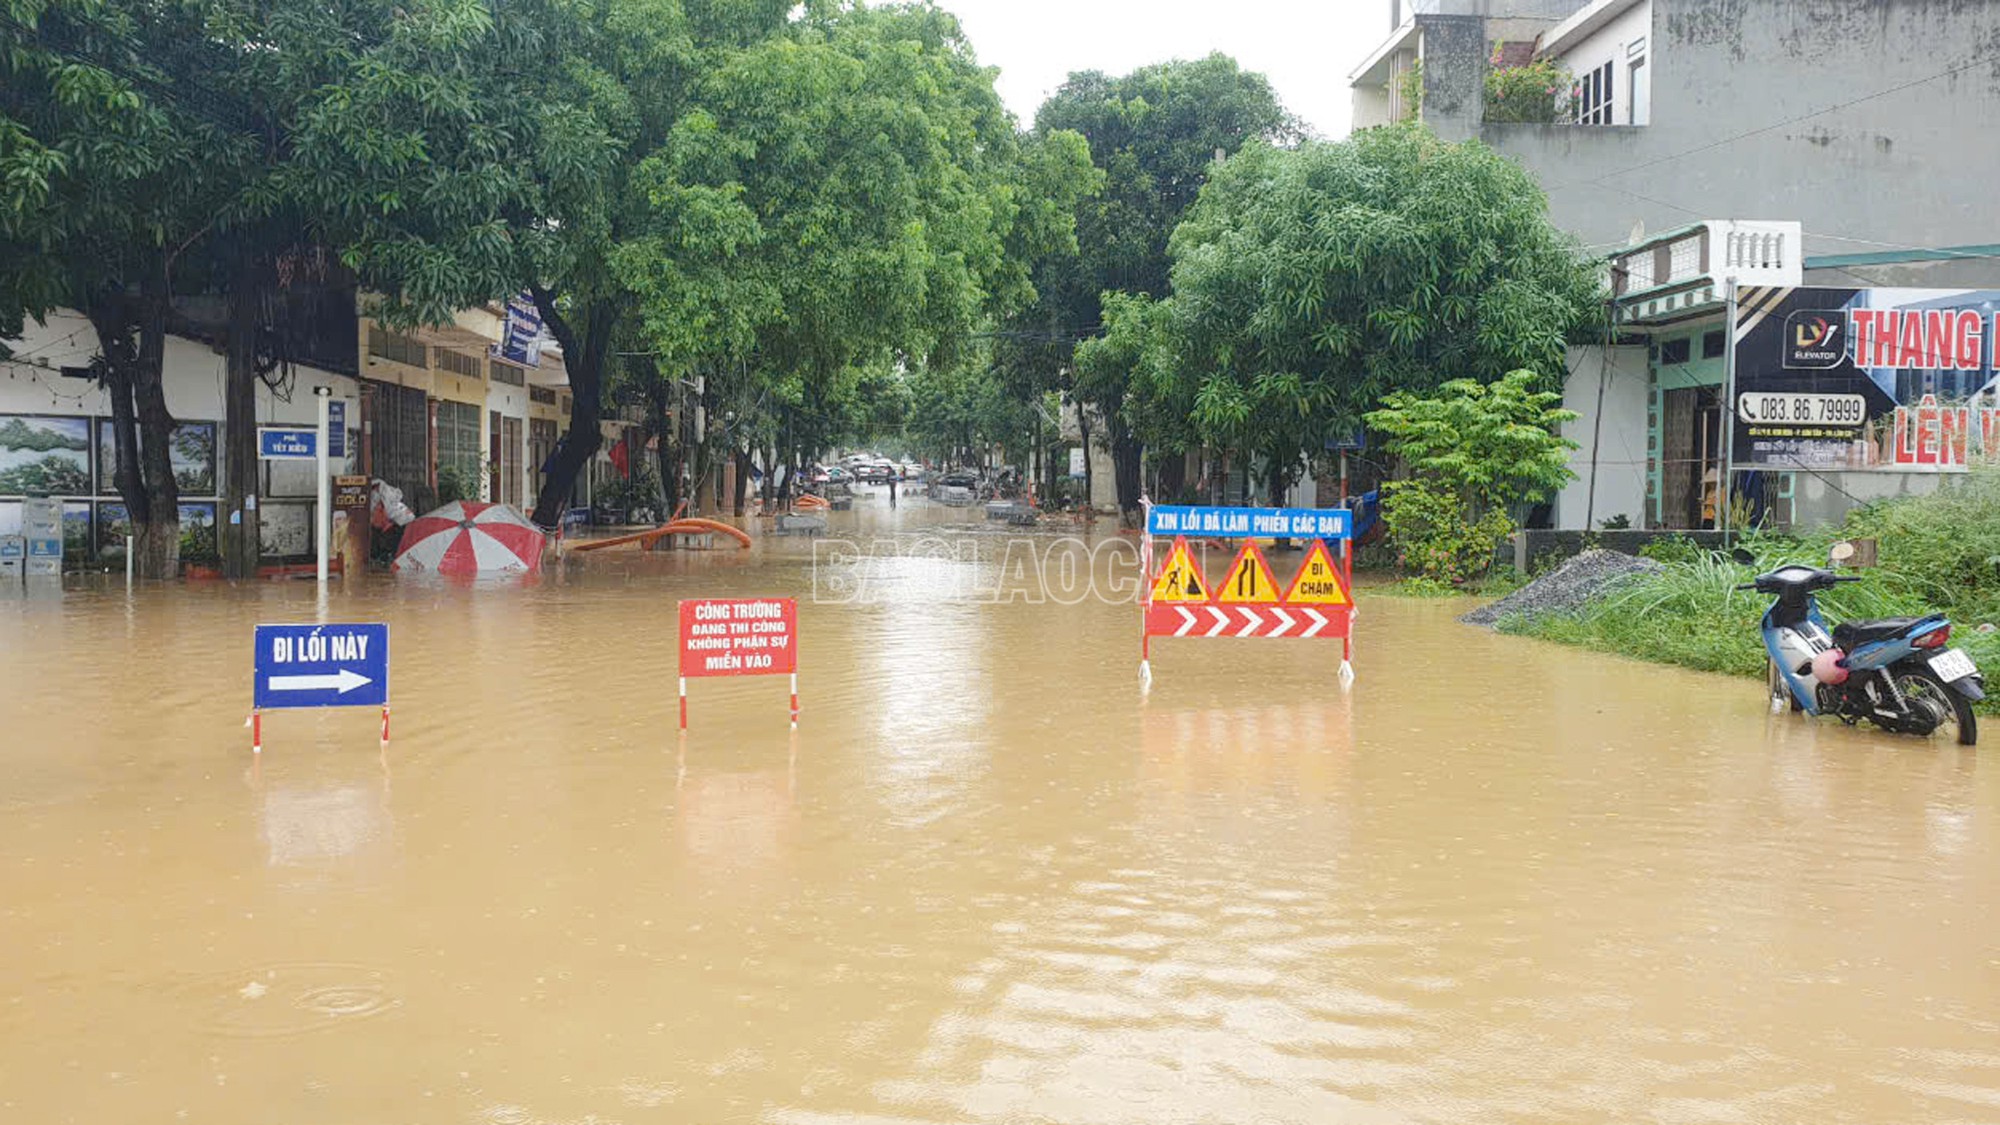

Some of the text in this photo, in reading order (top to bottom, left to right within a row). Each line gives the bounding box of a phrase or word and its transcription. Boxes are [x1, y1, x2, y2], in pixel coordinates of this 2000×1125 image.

[1852, 308, 1982, 370] THANG
[1795, 351, 1836, 360] ELEVATOR
[1894, 394, 1968, 466] LÊN
[1156, 511, 1177, 530] XIN
[1222, 510, 1249, 531] LÀM
[1293, 513, 1316, 534] CÁC
[1318, 516, 1342, 537] BẠN
[1312, 563, 1322, 575] ĐI
[695, 601, 730, 620] CÔNG
[729, 622, 749, 635] THI
[752, 619, 786, 633] CÔNG
[273, 626, 368, 663] ĐI LỐI NÀY
[687, 636, 731, 650] KHÔNG
[770, 634, 789, 650] SỰ
[745, 652, 773, 669] VÀO
